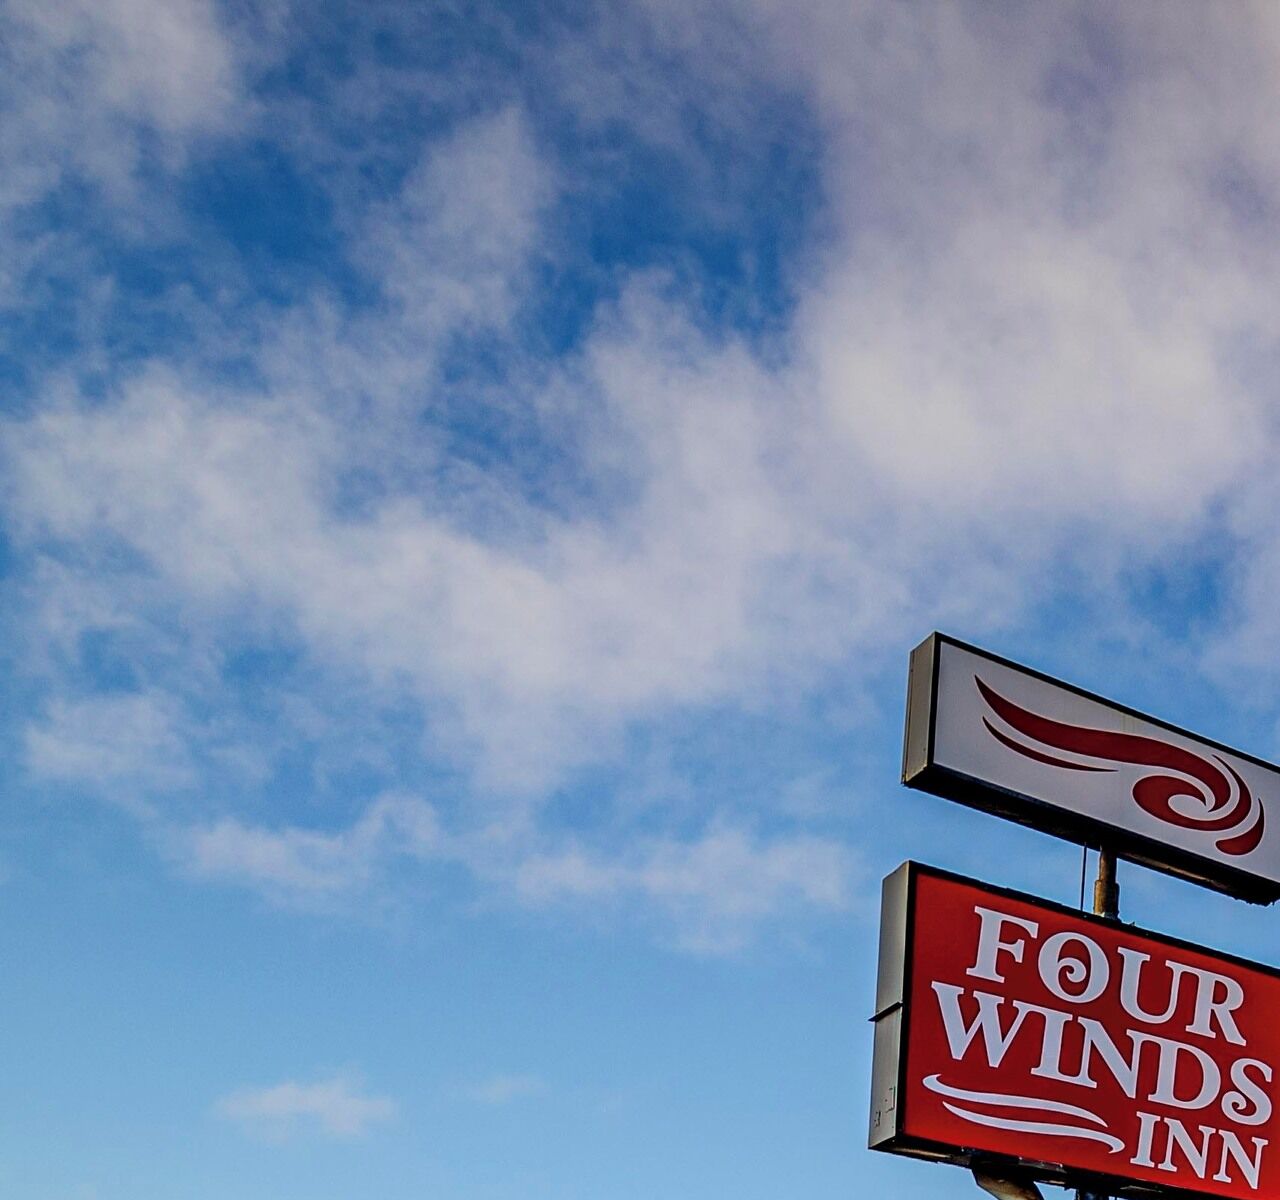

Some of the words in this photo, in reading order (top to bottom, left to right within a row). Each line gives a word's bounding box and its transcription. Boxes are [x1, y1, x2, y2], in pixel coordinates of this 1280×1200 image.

[965, 905, 1247, 1047] FOUR
[931, 980, 1273, 1126] WINDS
[1129, 1111, 1269, 1190] INN
